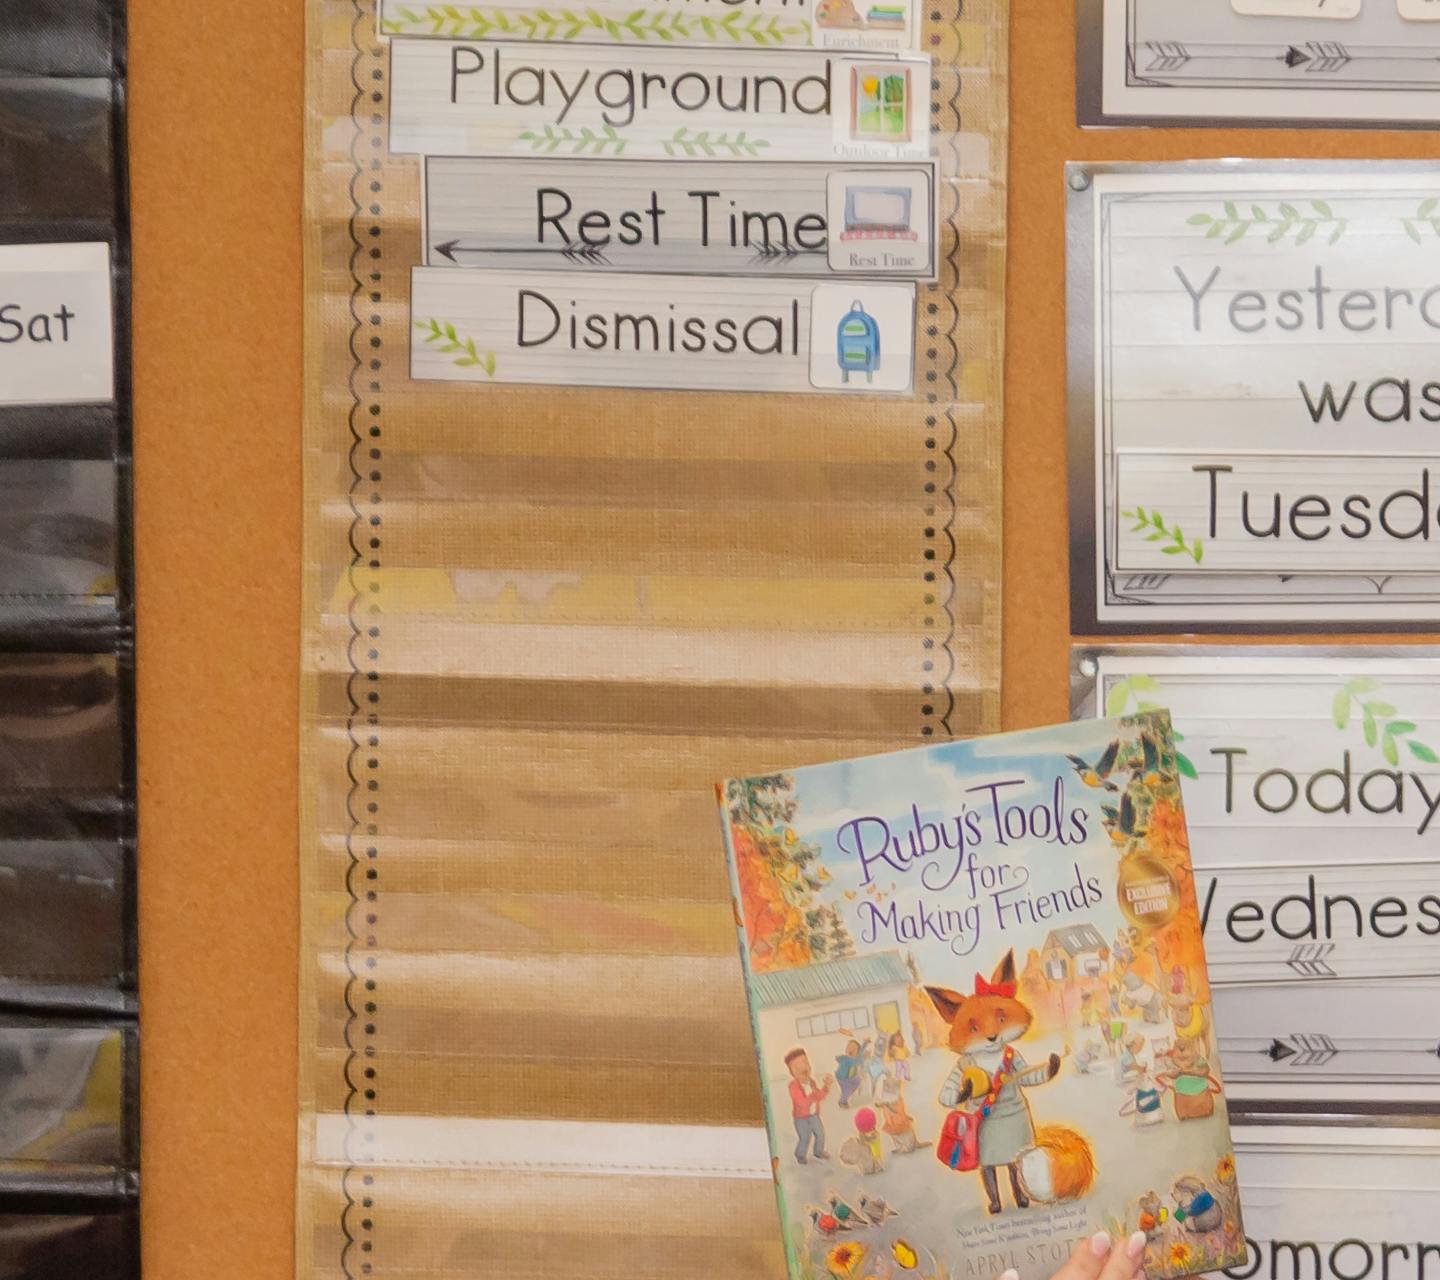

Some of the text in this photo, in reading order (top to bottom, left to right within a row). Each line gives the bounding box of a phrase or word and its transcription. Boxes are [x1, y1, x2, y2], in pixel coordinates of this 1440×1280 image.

[449, 45, 833, 128] Playground
[536, 188, 828, 250] Rest Time
[848, 252, 914, 267] Rest Time
[516, 289, 800, 357] Dismissal
[837, 775, 1088, 891] Ruby's Tools
[857, 862, 1103, 956] Making Friends
[966, 852, 1029, 899] for
